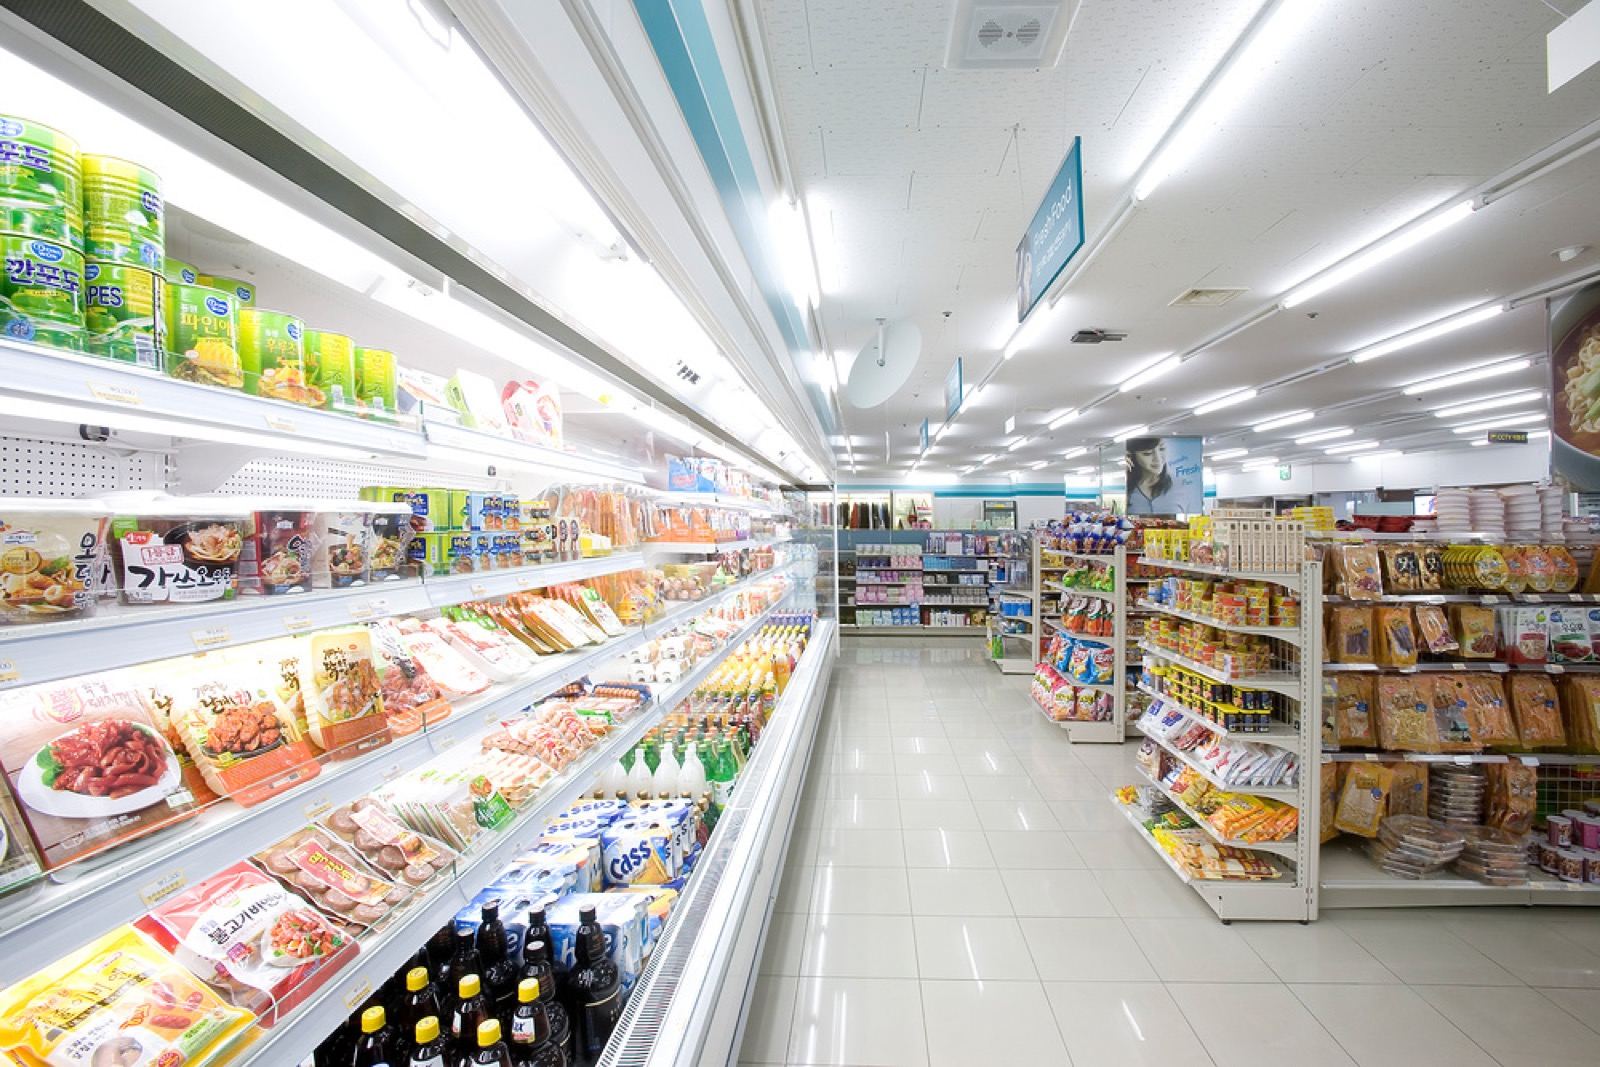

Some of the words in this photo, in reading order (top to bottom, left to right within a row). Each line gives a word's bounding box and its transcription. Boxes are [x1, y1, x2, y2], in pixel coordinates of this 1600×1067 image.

[1051, 177, 1072, 227] Food
[6, 258, 80, 294] 깐포도
[85, 284, 123, 307] PES
[1175, 463, 1201, 478] Fresh
[610, 839, 652, 880] Cass
